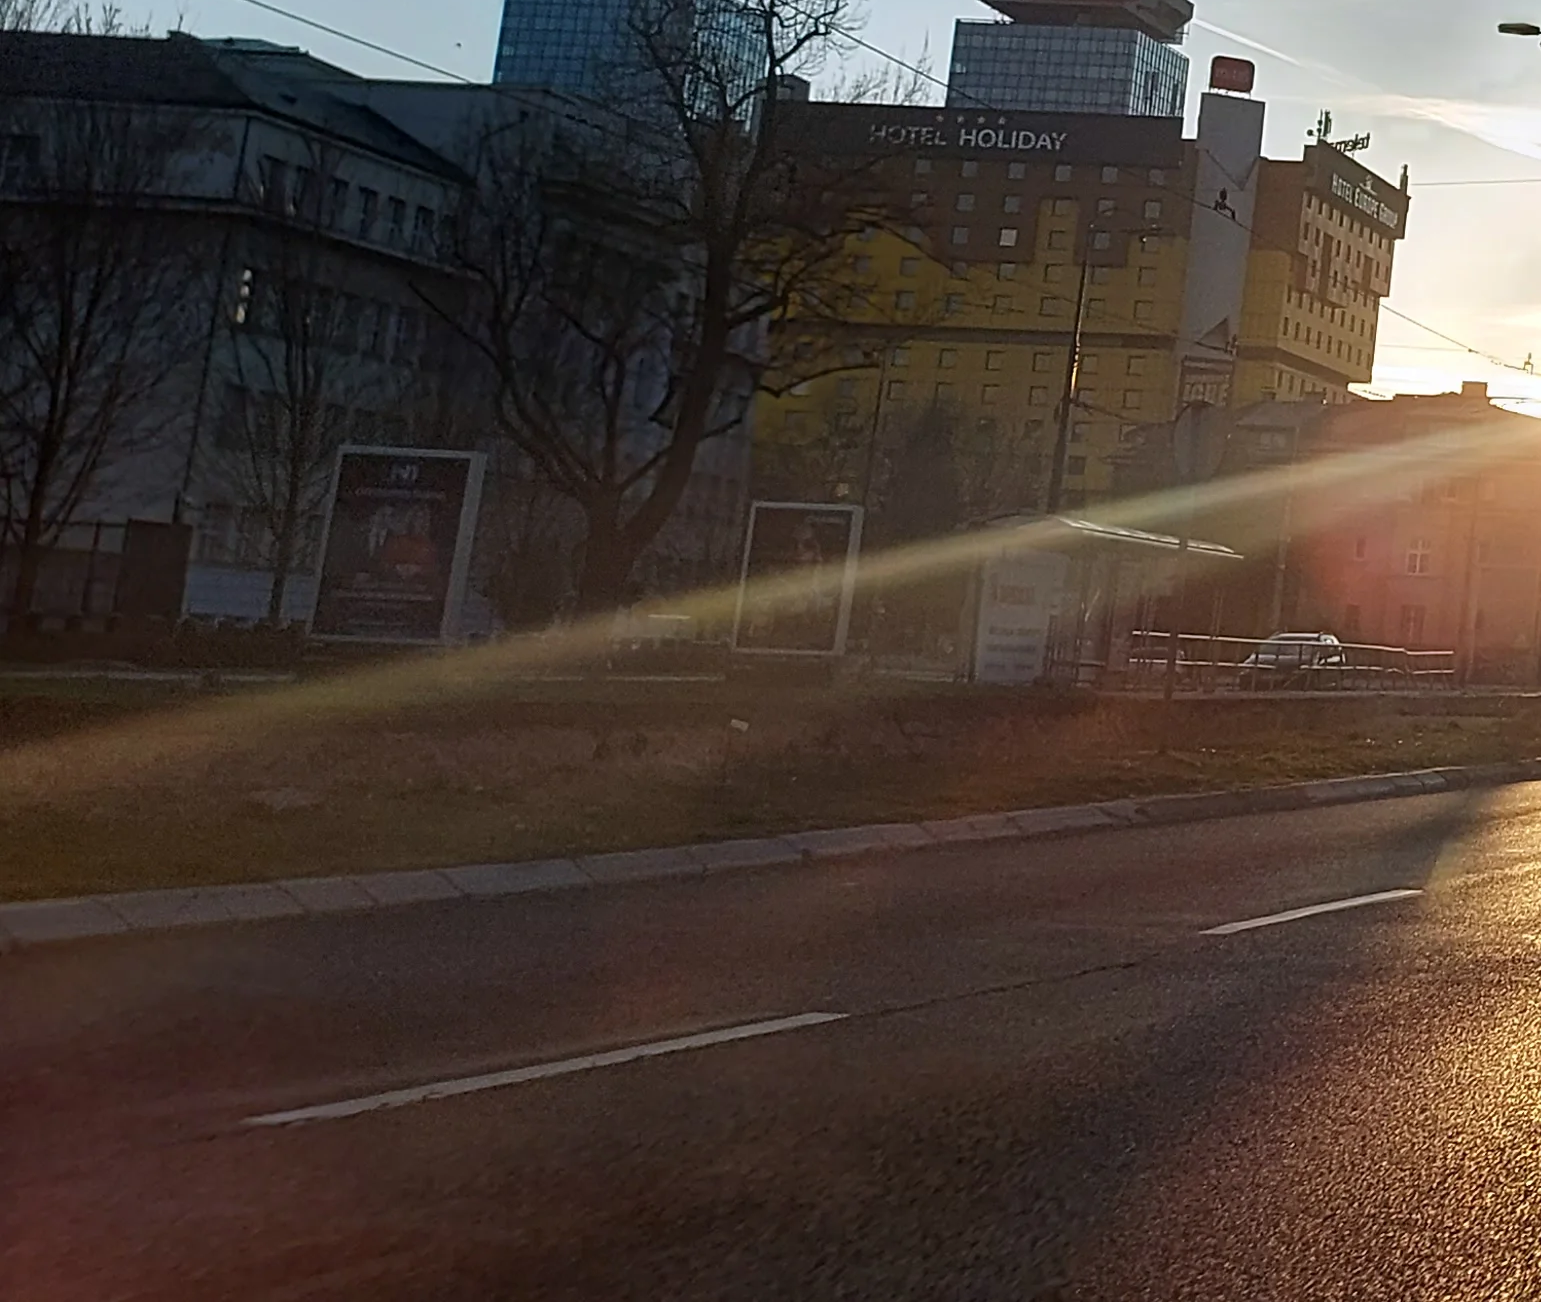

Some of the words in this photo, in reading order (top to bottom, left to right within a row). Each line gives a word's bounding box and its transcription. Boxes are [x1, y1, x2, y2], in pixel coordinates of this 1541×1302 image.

[869, 123, 947, 146] HOTEL
[959, 128, 1069, 150] HOLIDAY
[1331, 172, 1353, 204] HOTEL
